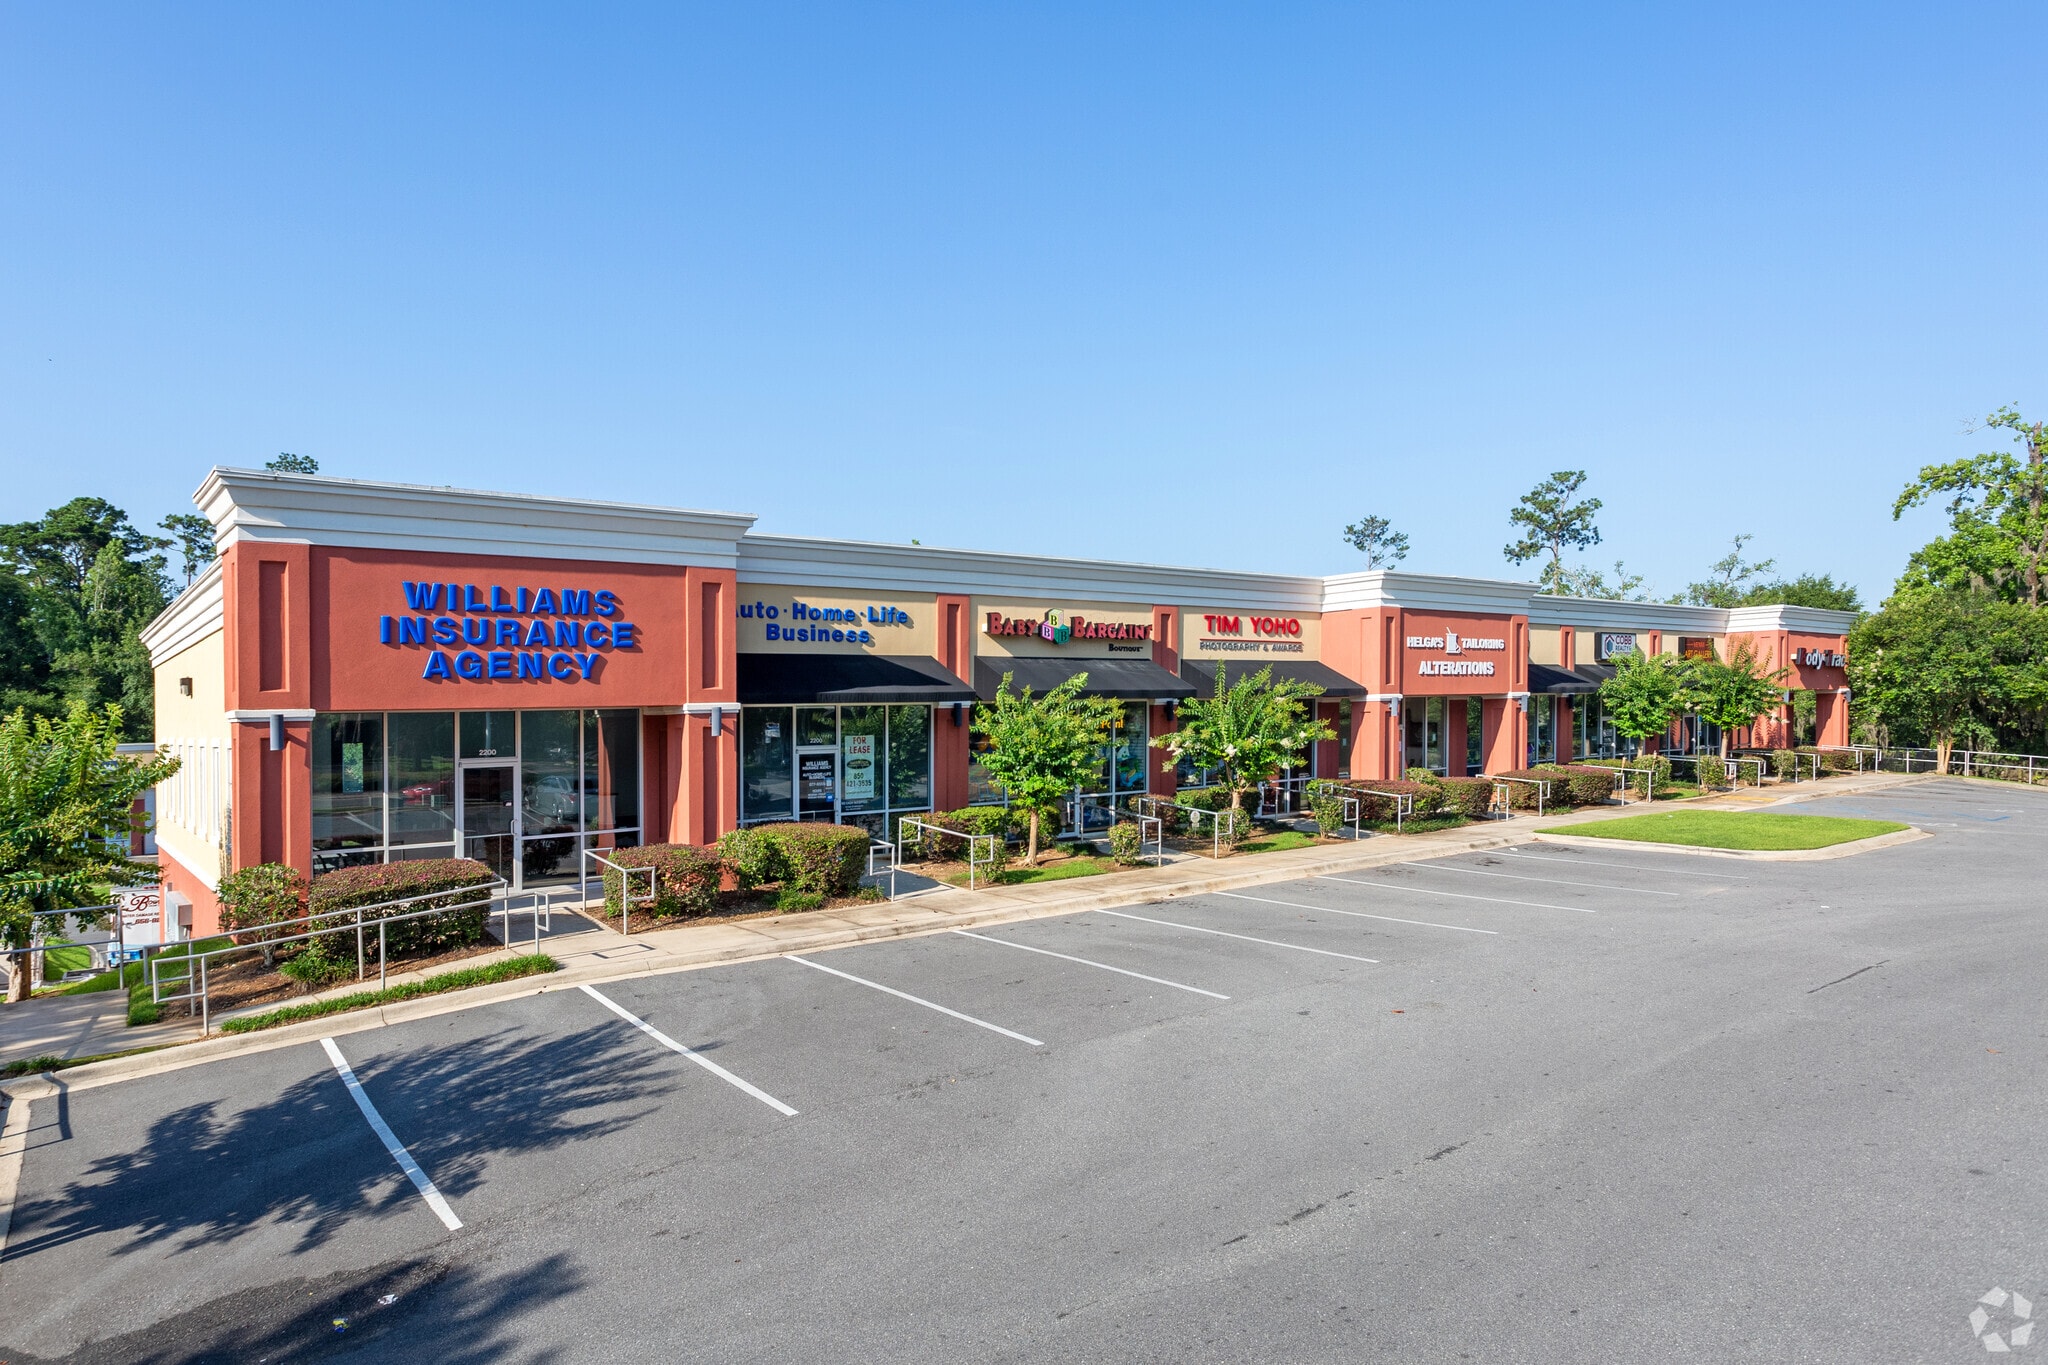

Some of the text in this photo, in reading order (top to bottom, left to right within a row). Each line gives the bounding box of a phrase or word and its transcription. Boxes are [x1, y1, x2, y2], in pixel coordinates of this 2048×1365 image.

[402, 581, 616, 617] WILLIAMS
[735, 601, 908, 624] uto Home Life
[380, 615, 635, 648] INSURANCE
[766, 623, 870, 643] Business
[1204, 614, 1300, 635] TIM YOHO
[1199, 641, 1260, 651] PHOTOGRAPHY
[1271, 642, 1304, 653] AWARDS
[1406, 636, 1505, 649] HELGA'S TAILORING
[1615, 635, 1632, 645] COBB
[422, 651, 599, 679] AGENCY
[1418, 660, 1495, 675] ALTERATIONS
[852, 736, 866, 745] FOR
[849, 746, 871, 754] LEASE
